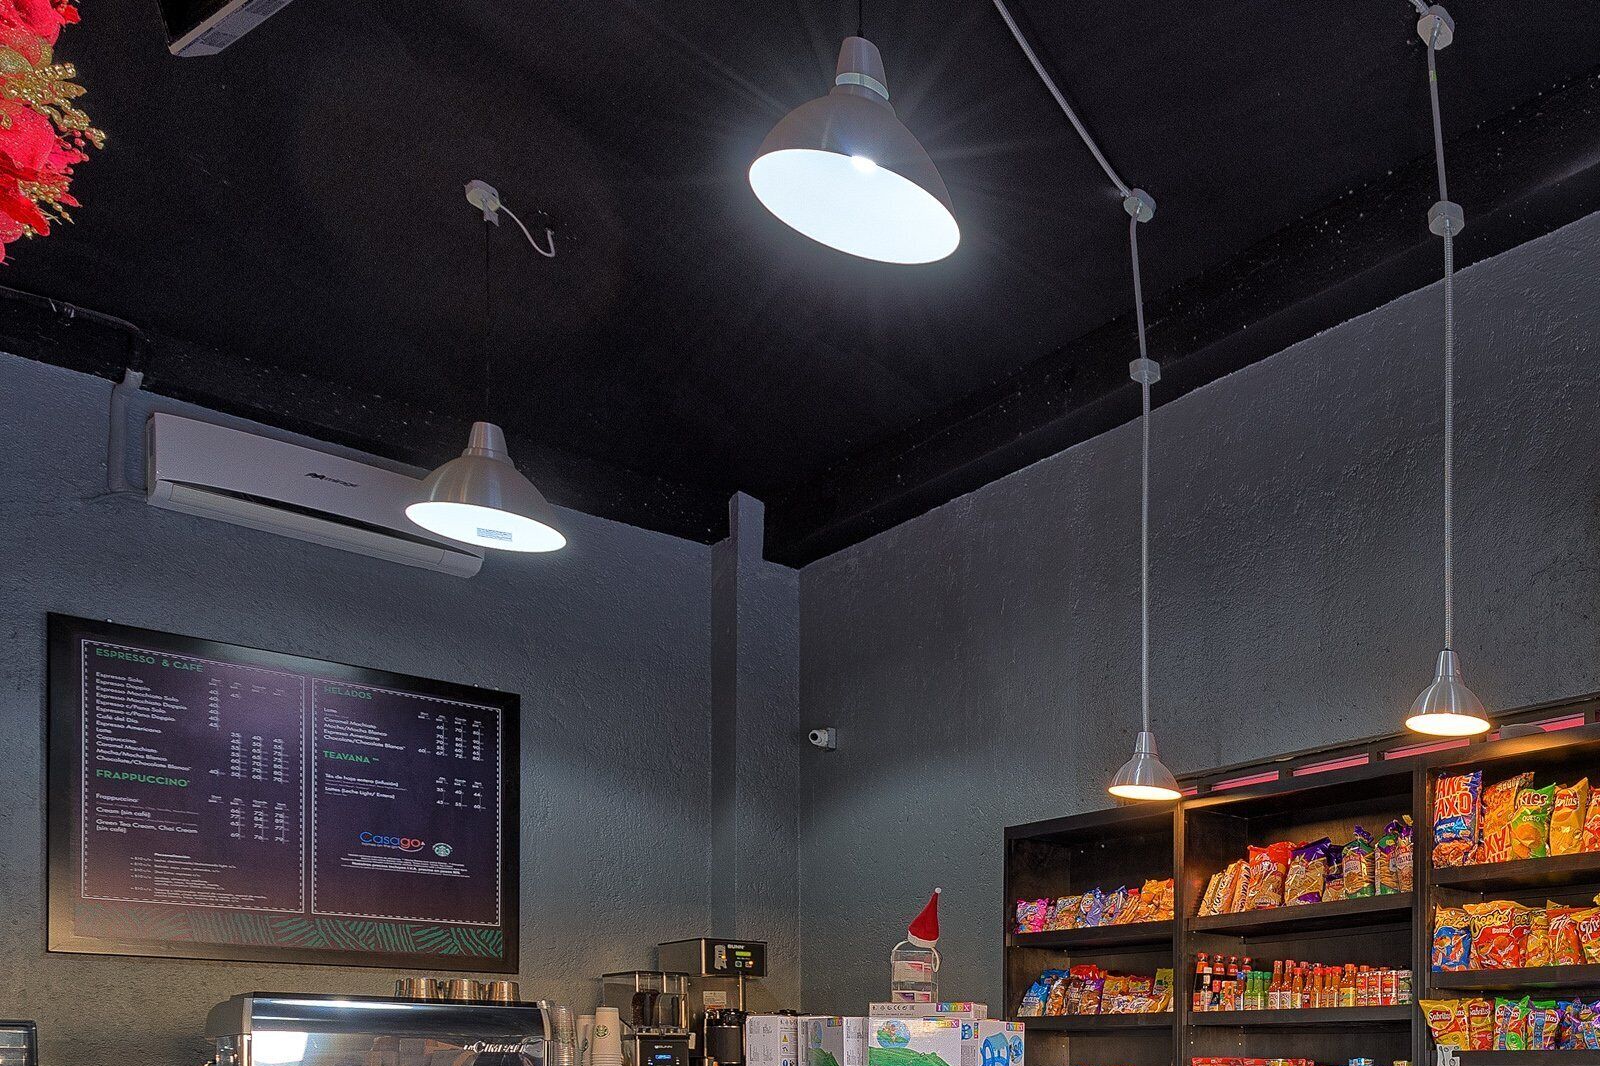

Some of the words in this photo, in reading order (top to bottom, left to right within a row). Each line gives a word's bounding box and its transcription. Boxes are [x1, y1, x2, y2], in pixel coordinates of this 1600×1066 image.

[96, 648, 155, 664] ESPRESSO
[324, 687, 372, 699] HELADOS
[323, 751, 371, 763] TEAVANA
[360, 831, 421, 849] Casago
[937, 1003, 971, 1012] INTEX
